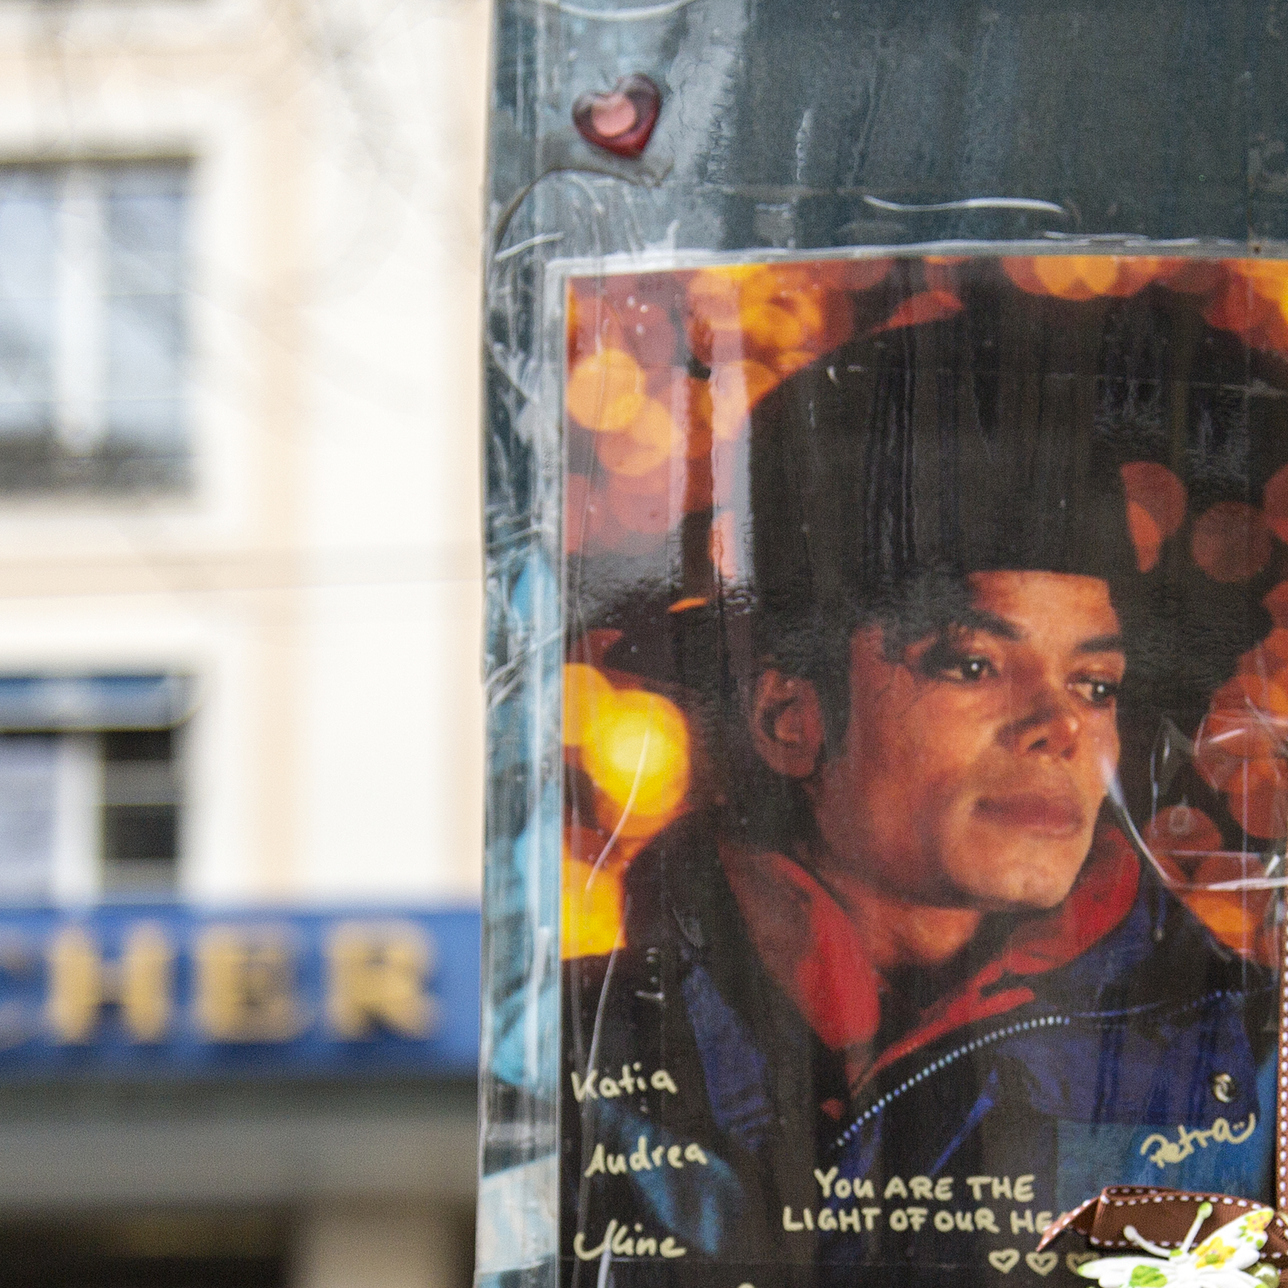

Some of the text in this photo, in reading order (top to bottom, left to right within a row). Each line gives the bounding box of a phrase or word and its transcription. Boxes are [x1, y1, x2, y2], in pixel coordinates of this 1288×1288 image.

[571, 1062, 678, 1103] Katia
[584, 1135, 708, 1178] Andrea
[884, 1176, 953, 1200] ARE
[967, 1174, 1035, 1201] THE
[783, 1206, 1066, 1234] LIGHT OF OUR HE
